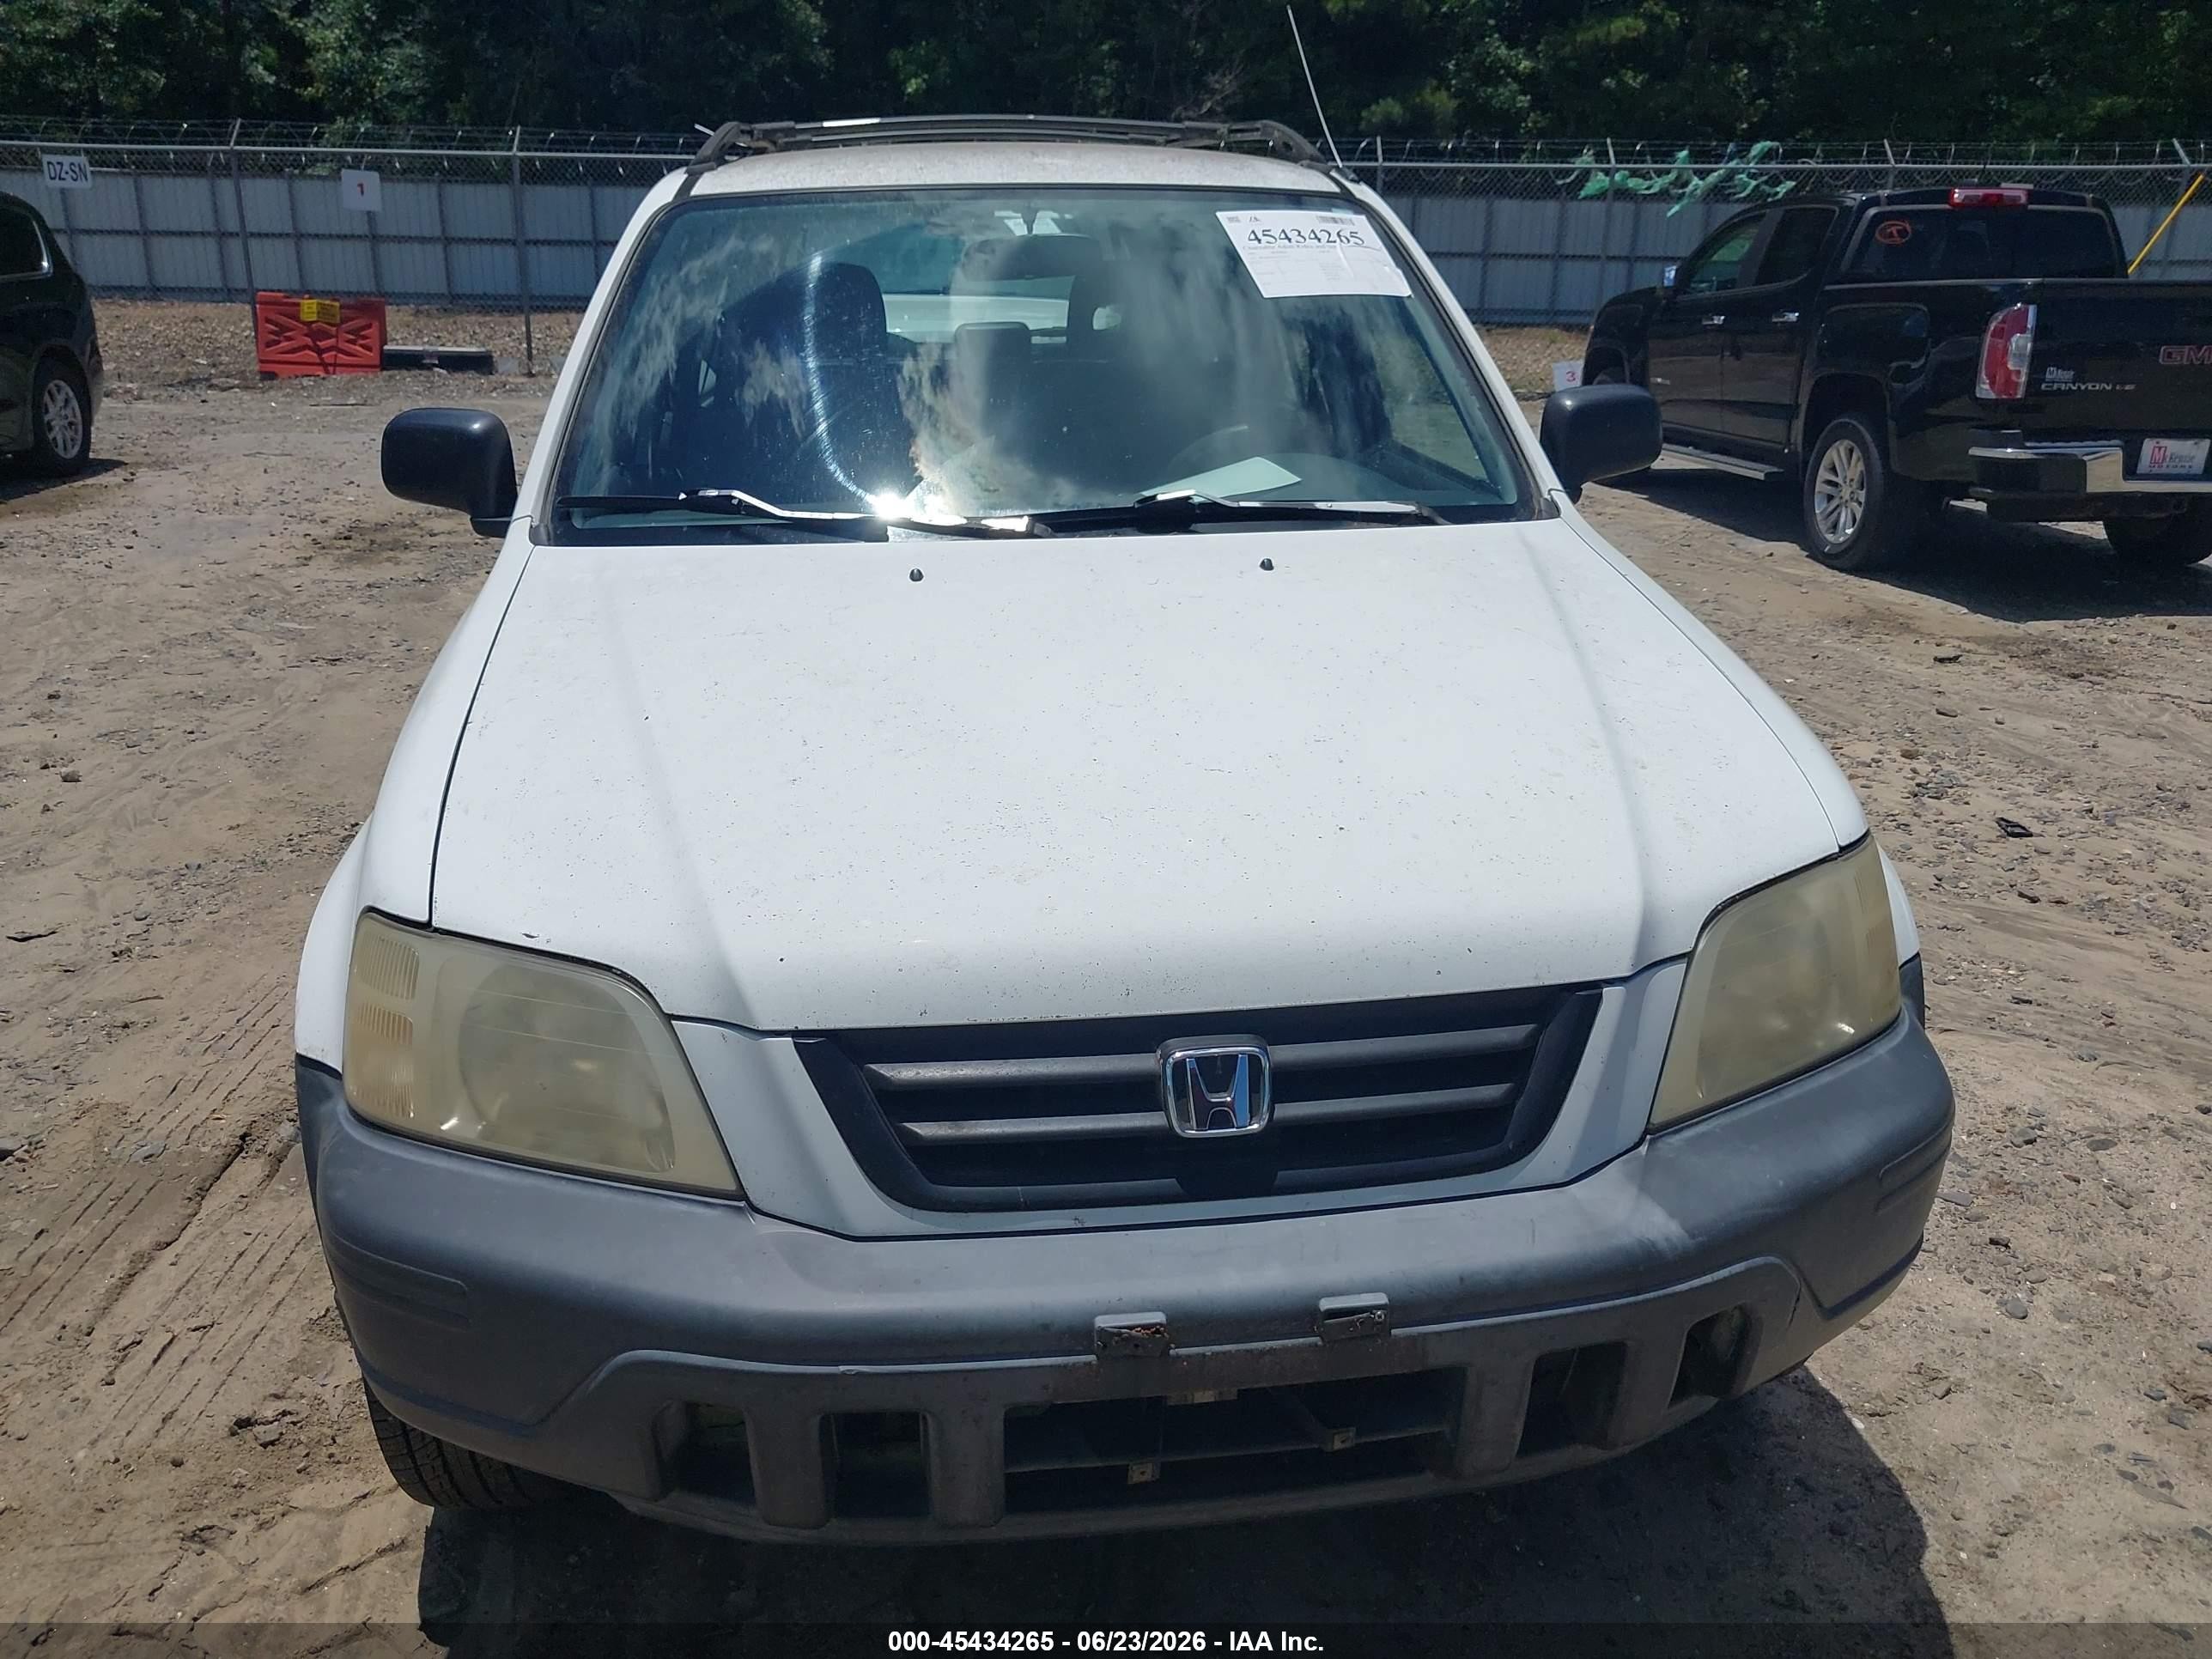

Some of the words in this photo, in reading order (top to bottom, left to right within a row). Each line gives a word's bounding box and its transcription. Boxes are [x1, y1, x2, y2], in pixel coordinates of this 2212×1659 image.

[46, 161, 88, 182] DZ-SN
[356, 182, 365, 198] 1
[1247, 228, 1366, 246] 45434265
[1565, 370, 1577, 383] 3
[2040, 382, 2112, 391] CANYON
